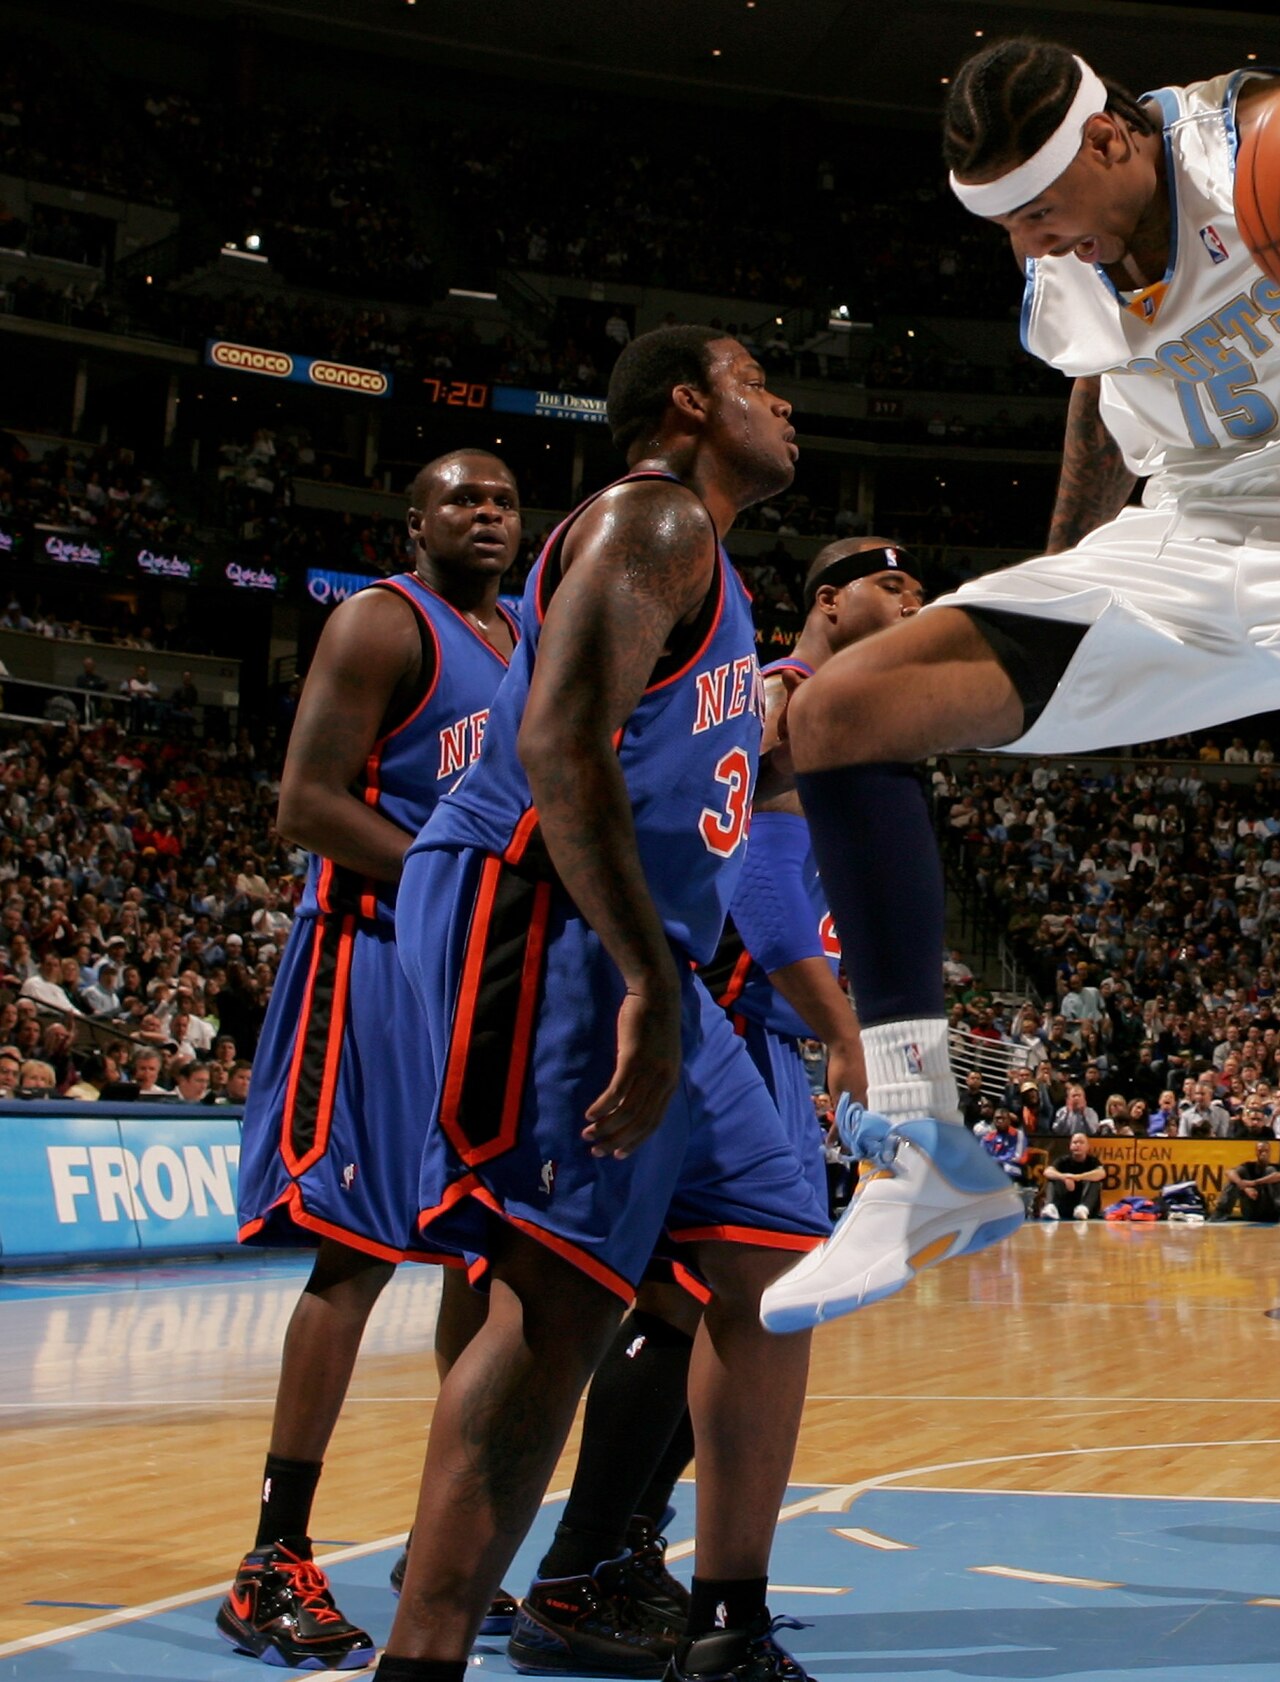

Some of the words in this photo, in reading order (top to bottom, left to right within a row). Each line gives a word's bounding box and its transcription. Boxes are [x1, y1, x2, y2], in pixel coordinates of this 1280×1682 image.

[421, 377, 487, 409] 7:20
[1174, 362, 1279, 449] 15
[697, 745, 753, 859] 3
[1138, 1146, 1172, 1161] CAN
[1103, 1164, 1223, 1192] BROWN
